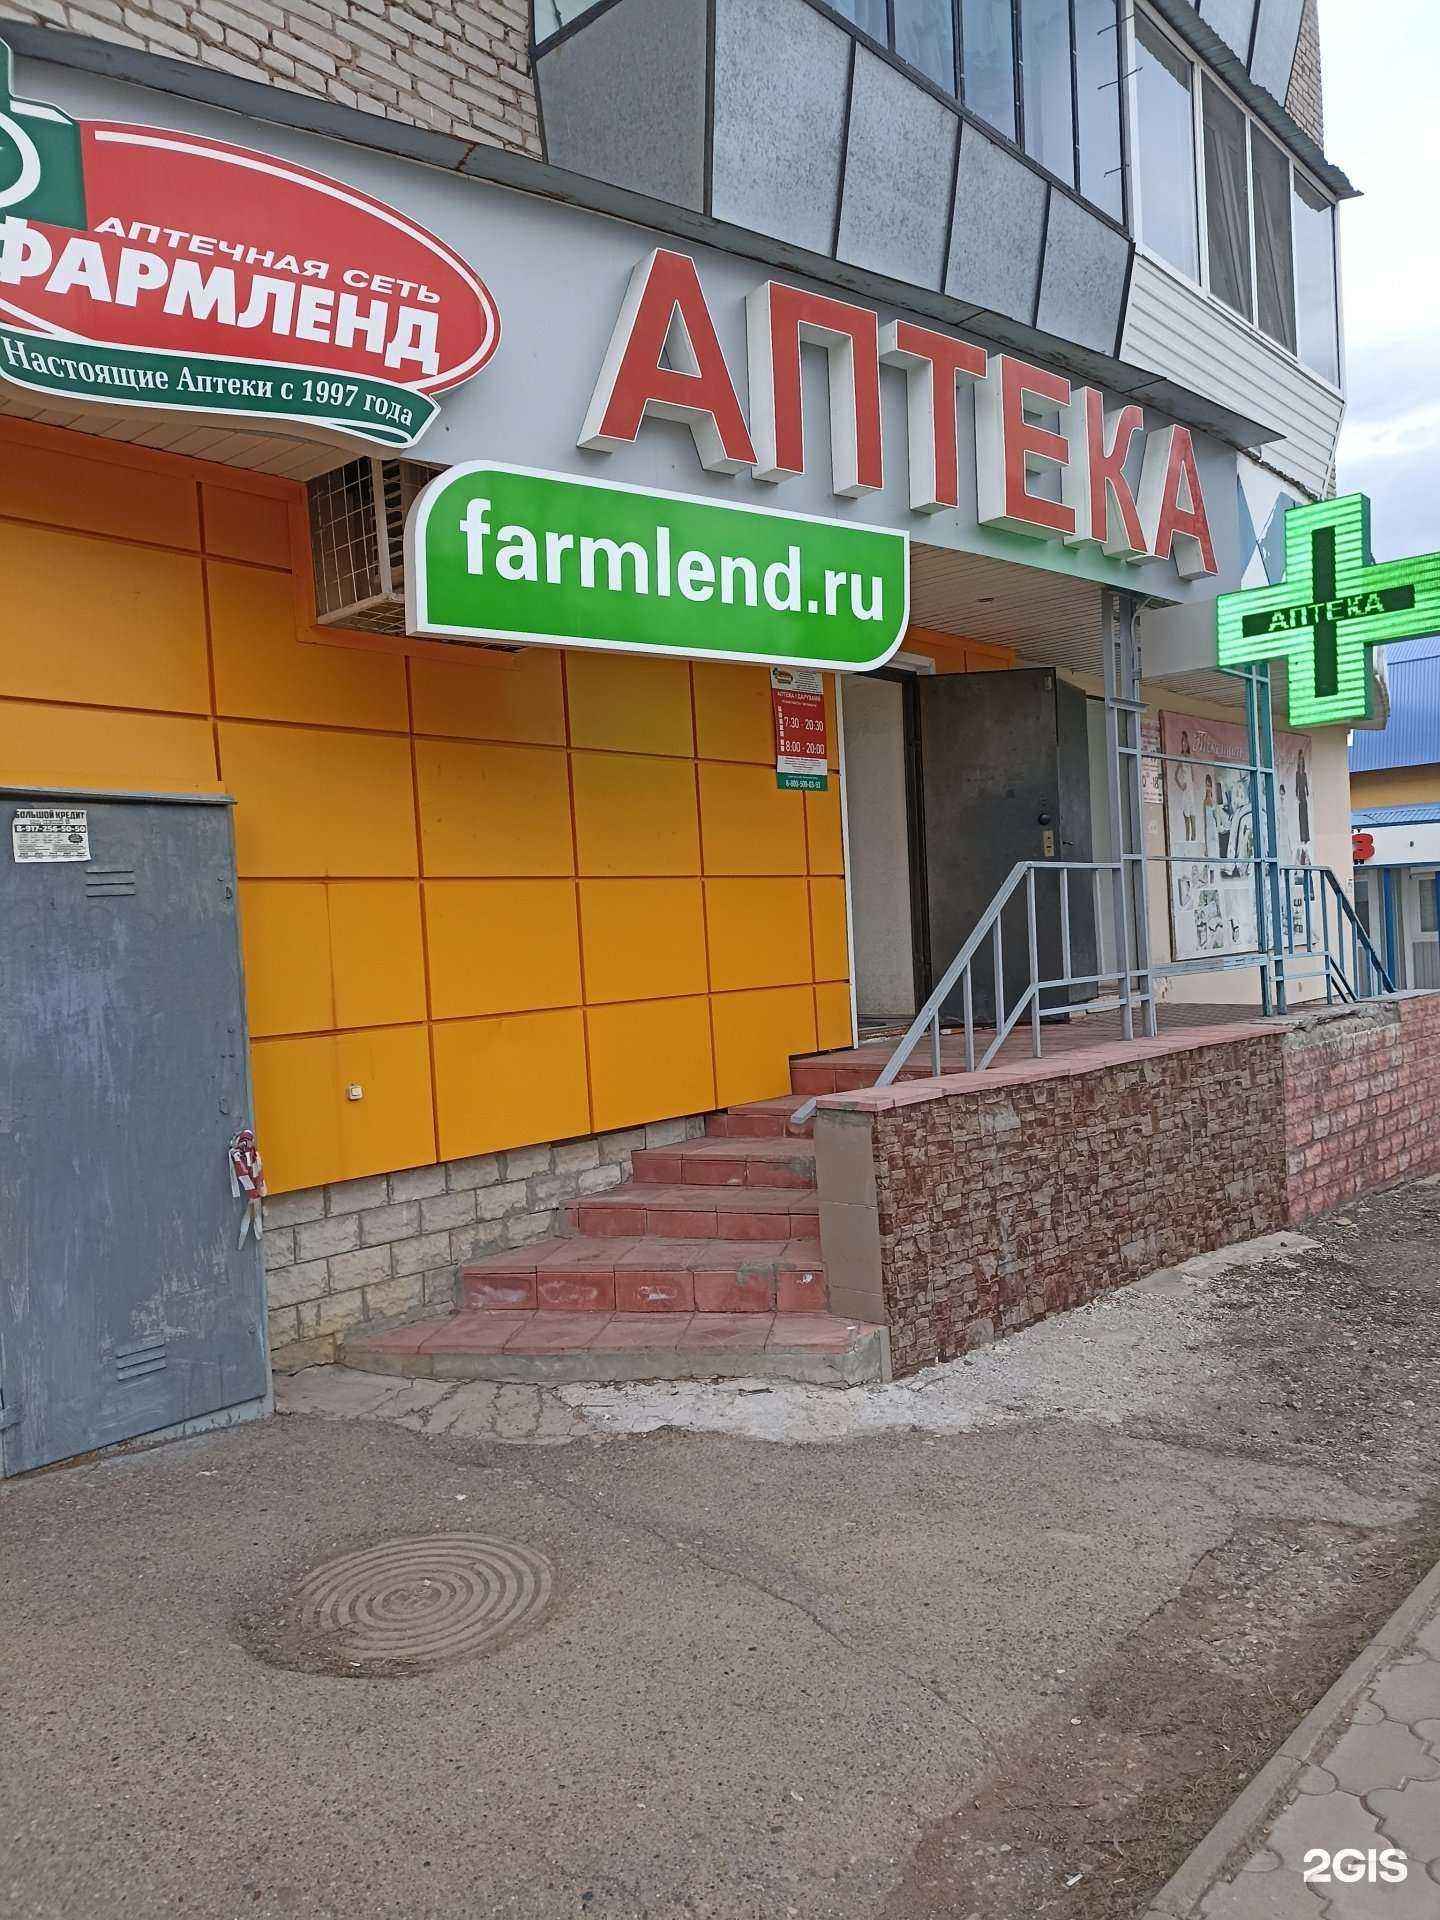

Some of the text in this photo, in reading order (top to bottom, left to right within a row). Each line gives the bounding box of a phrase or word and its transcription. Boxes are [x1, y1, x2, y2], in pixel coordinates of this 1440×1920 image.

[0, 215, 440, 376] ФАРМЛЕНД
[93, 216, 441, 304] АПТЕЧНАЯ СЕТЬ
[1, 336, 414, 427] Настоящие Аптеки с 1997 года
[578, 246, 1220, 580] АПТЕКА
[459, 497, 885, 622] farmlend.ru
[1268, 593, 1385, 632] АПТЕКА
[785, 741, 801, 752] 8:00
[806, 743, 825, 754] 20:00
[805, 719, 824, 731] 20:30
[55, 811, 84, 820] КРЕДИТ
